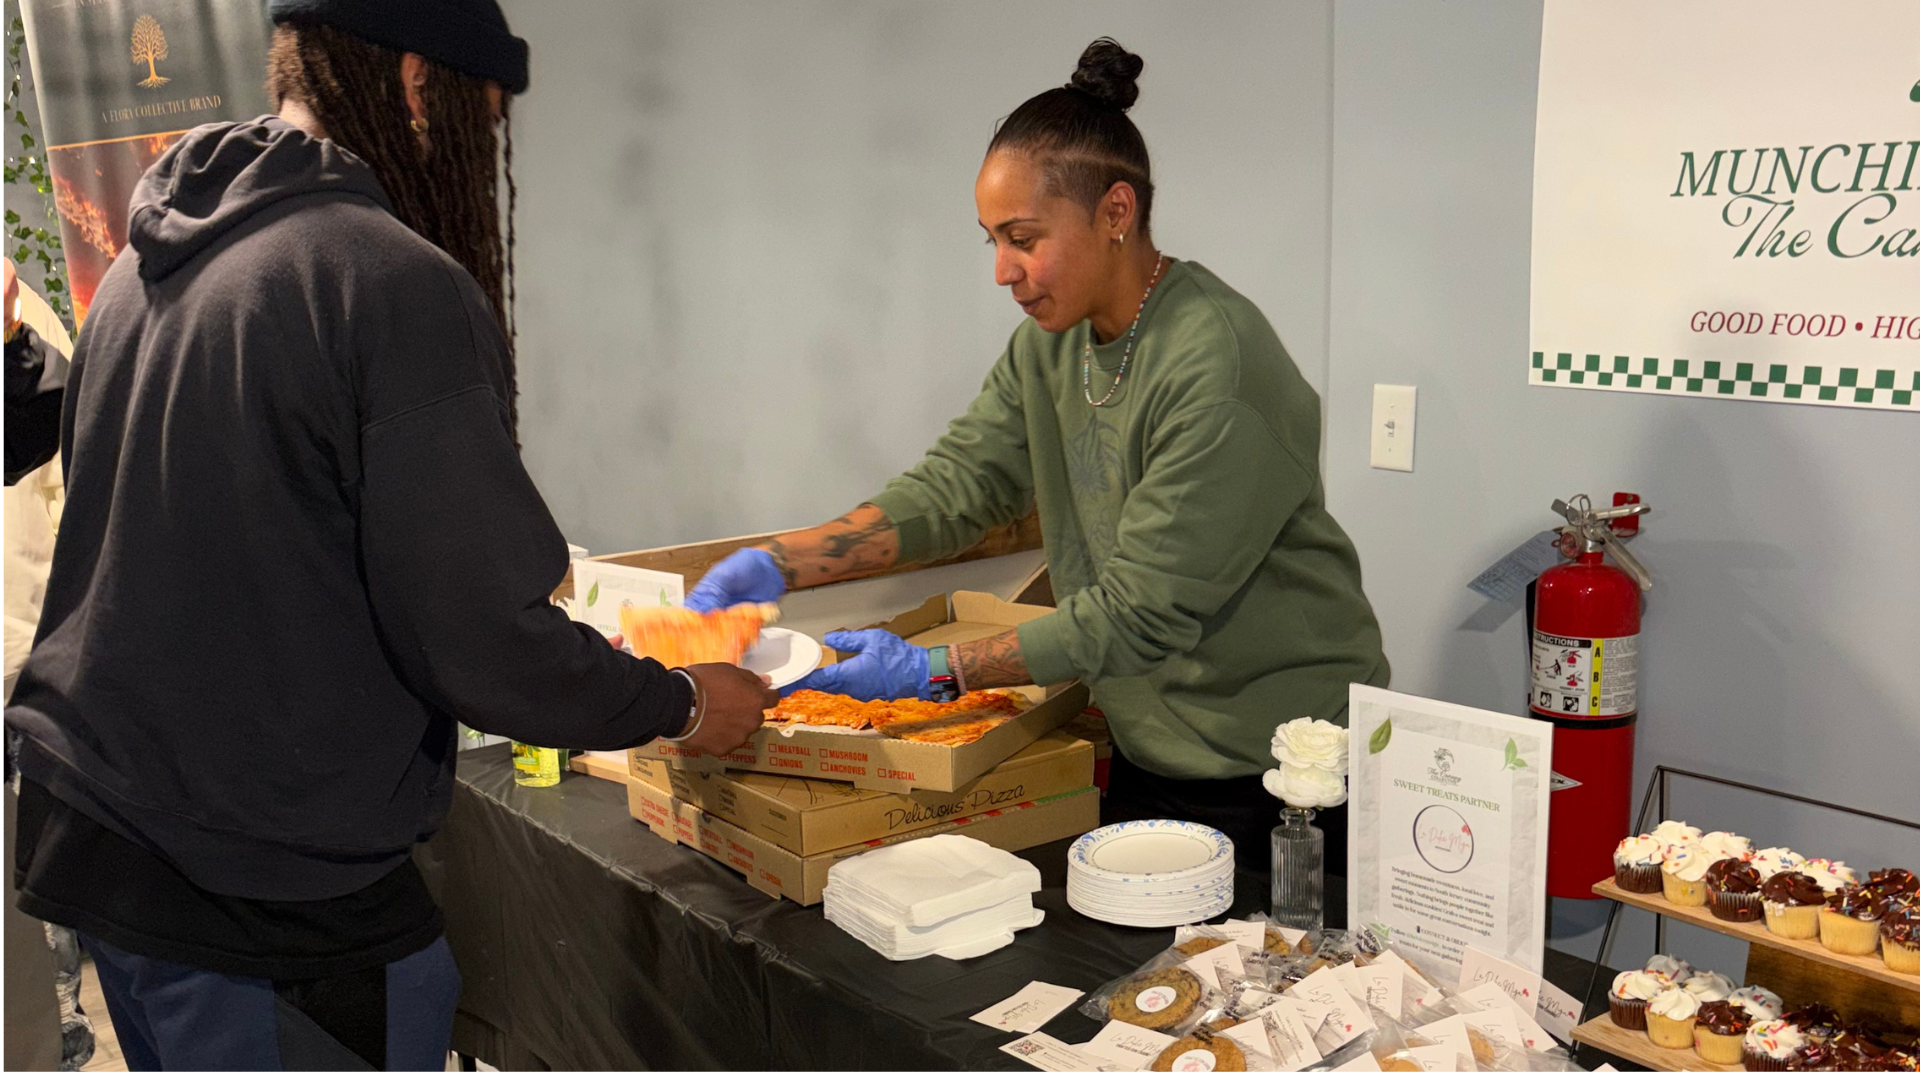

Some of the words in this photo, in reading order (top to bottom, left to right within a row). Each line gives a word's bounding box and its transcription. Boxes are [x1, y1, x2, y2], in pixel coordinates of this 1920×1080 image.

[109, 107, 134, 122] FLORA
[135, 99, 187, 117] COLLECTIVE
[189, 94, 222, 112] BRAND
[1670, 140, 1920, 197] MUNCHI
[1722, 193, 1813, 259] The
[1690, 310, 1764, 334] GOOD
[1768, 313, 1847, 337] FOOD
[1870, 315, 1920, 340] HIG
[1594, 646, 1601, 658] A
[1593, 671, 1599, 682] B
[1591, 696, 1598, 707] C
[728, 752, 757, 764] PEPPERS
[778, 758, 803, 769] ONIONS
[829, 763, 867, 776] ANCHOVIES
[887, 769, 916, 781] SPECIAL
[777, 744, 811, 757] MEATBALL
[828, 750, 869, 762] MUSHROOM
[885, 801, 964, 830] Delicious
[967, 785, 1025, 809] Pizza
[1393, 778, 1425, 793] SWEET
[1426, 786, 1459, 802] TREATS
[1460, 795, 1500, 812] PARTNER
